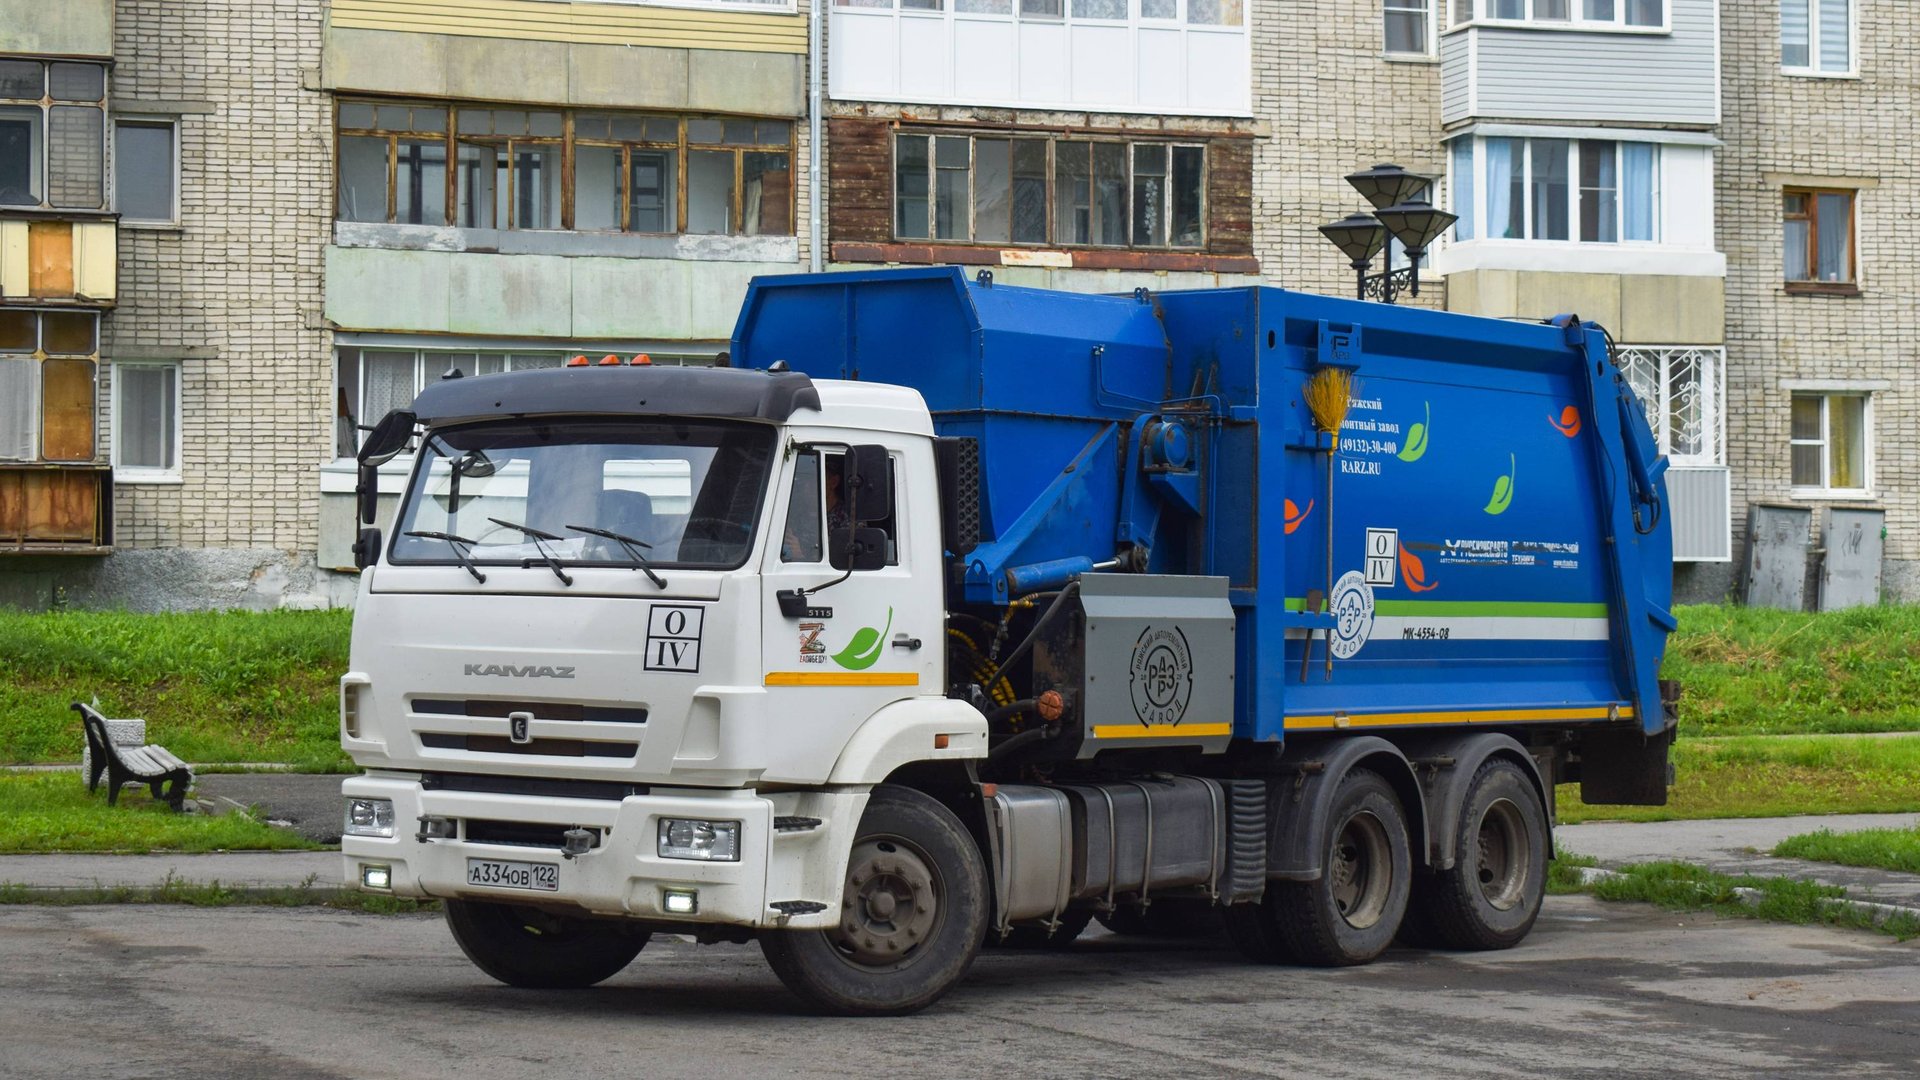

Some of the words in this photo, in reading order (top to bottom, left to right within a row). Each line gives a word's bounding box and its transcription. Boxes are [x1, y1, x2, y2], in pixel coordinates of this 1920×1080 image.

[1378, 422, 1400, 434] завод
[1340, 438, 1397, 455] (49132)-30-400
[1341, 459, 1382, 475] RARZ.RU
[1371, 560, 1389, 580] IV
[808, 609, 832, 617] 5115
[656, 641, 689, 667] IV
[464, 664, 576, 679] KAMAZ
[1141, 699, 1183, 725] ЗАВОД
[532, 866, 555, 883] 122
